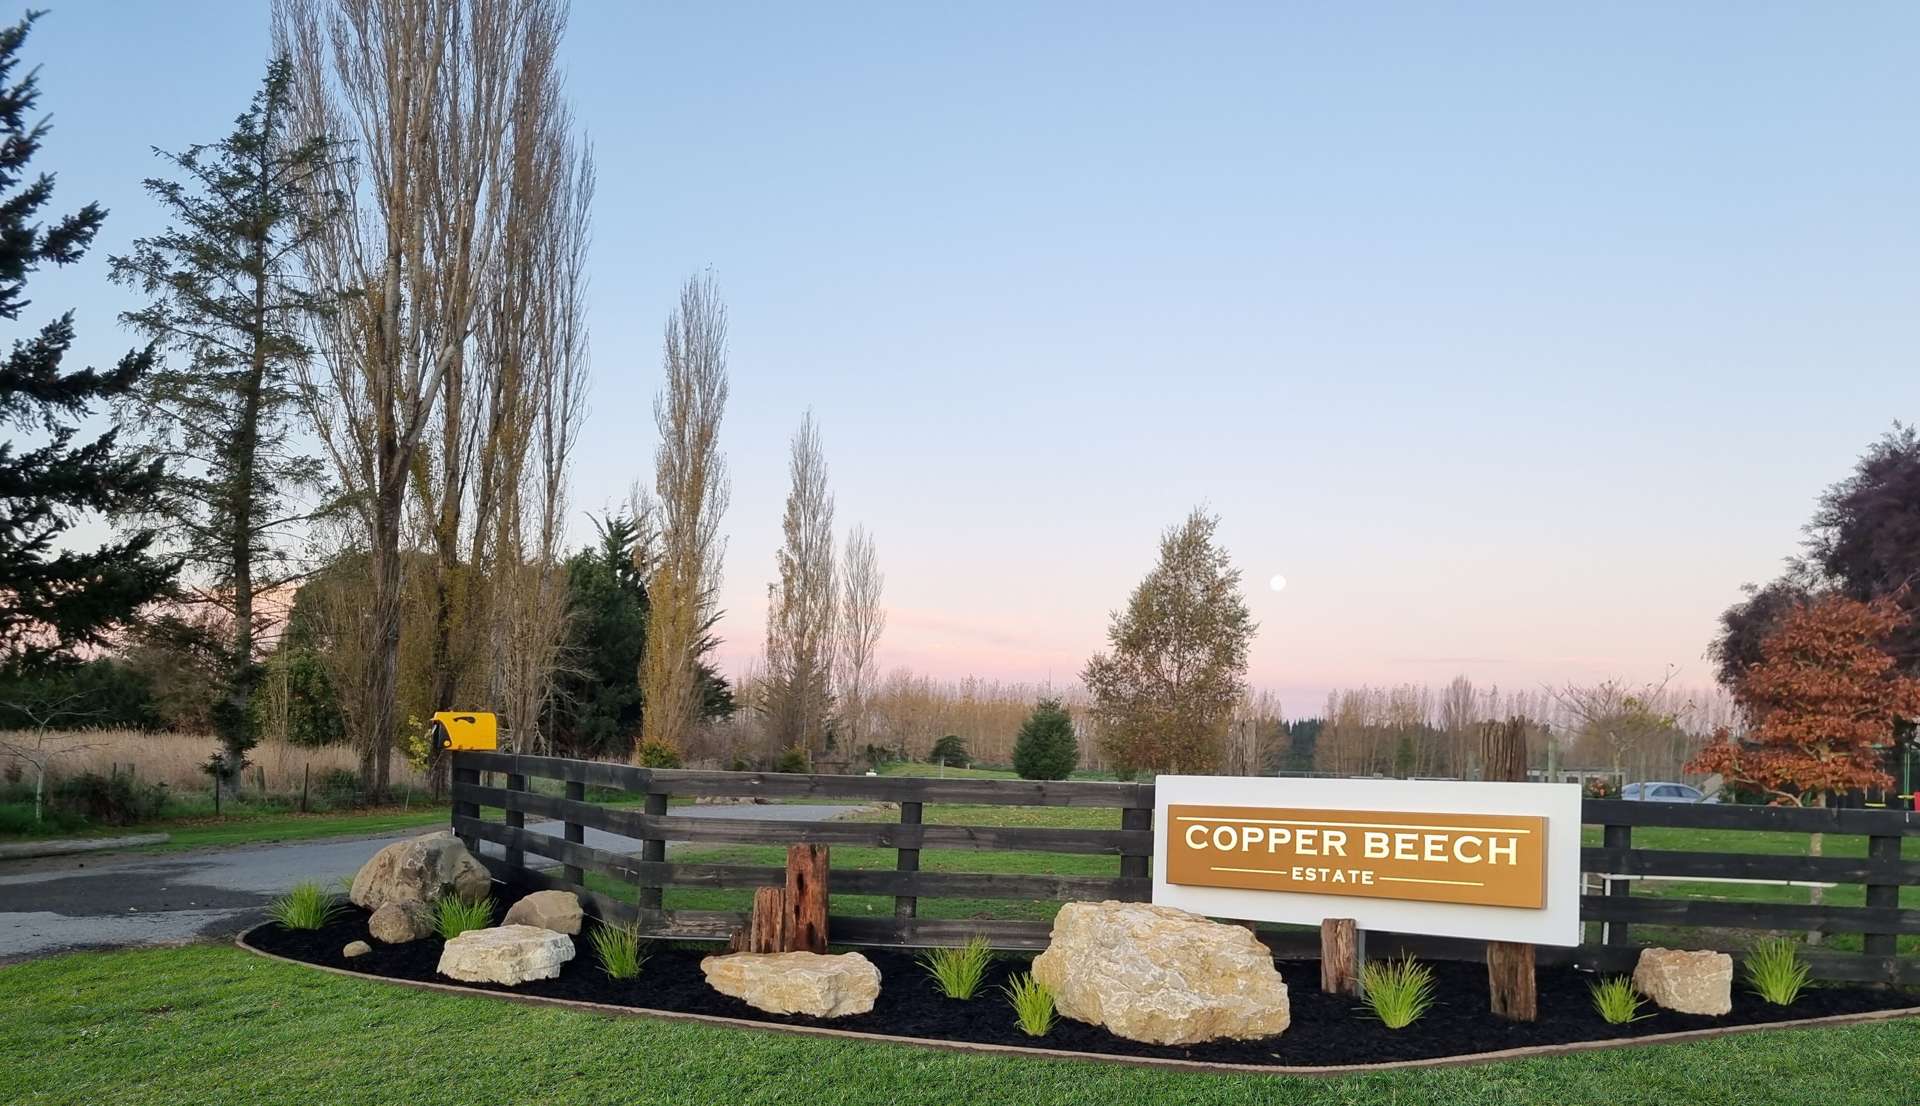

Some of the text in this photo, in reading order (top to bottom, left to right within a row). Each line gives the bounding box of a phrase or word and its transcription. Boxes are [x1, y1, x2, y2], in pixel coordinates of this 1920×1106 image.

[1184, 824, 1519, 866] COPPER BEECH
[1291, 866, 1375, 886] ESTATE
